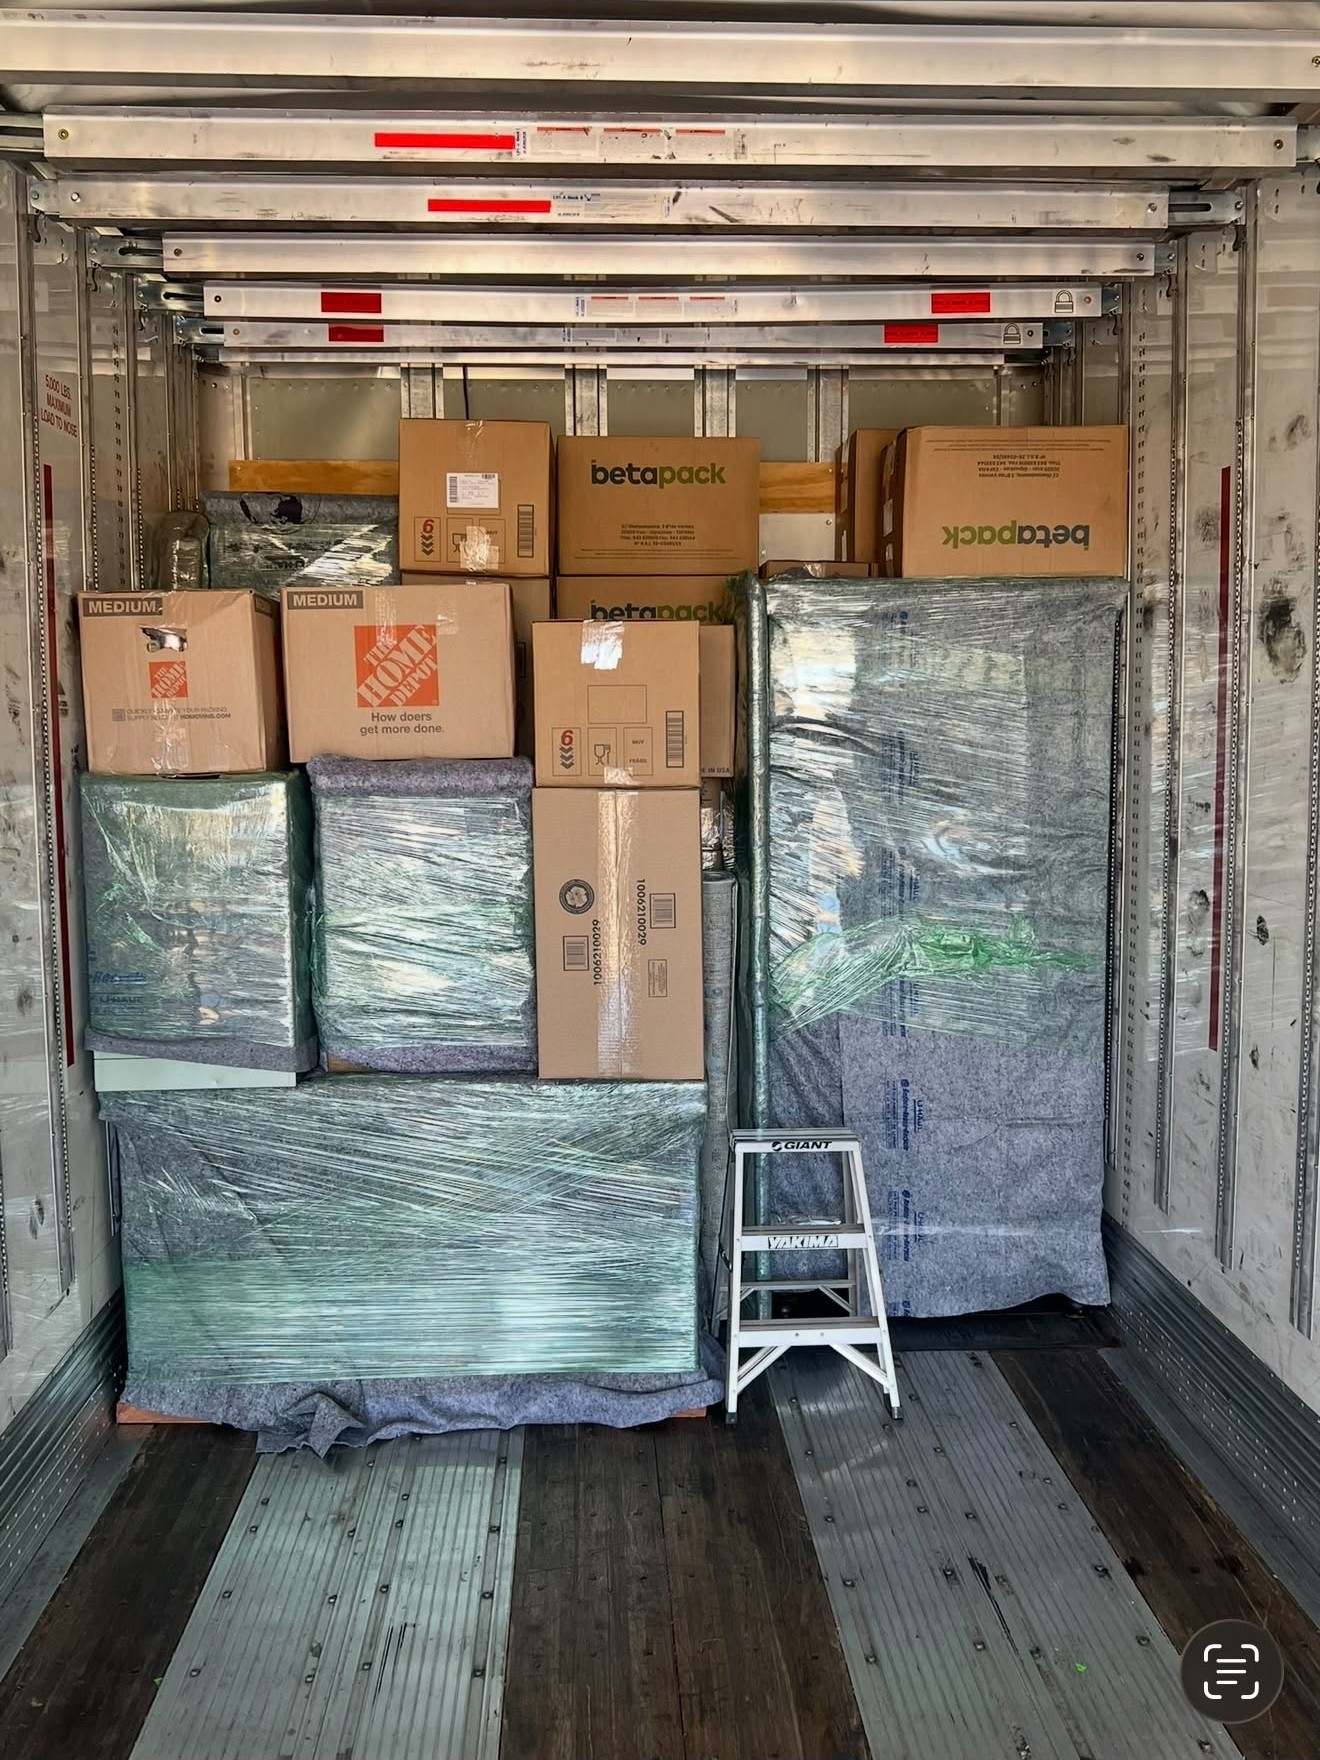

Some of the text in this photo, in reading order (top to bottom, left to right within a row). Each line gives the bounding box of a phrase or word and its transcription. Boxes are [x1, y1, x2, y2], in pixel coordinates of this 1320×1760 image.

[46, 391, 72, 418] MAXIMUM
[40, 407, 55, 426] LOAD
[63, 419, 78, 438] NOSE
[591, 460, 726, 489] betapack
[422, 519, 435, 534] 6
[942, 520, 1090, 550] betapack
[88, 600, 156, 614] MEDIUM
[293, 594, 357, 606] MEDIUM
[590, 600, 725, 621] betapack
[358, 625, 436, 707] HOME
[363, 640, 397, 667] THE
[151, 661, 186, 698] HOME
[389, 654, 438, 707] DEPOT
[360, 723, 445, 736] get more done.
[371, 711, 432, 722] How doers
[560, 729, 574, 746] 6
[636, 879, 647, 946] 1006210029
[592, 919, 602, 985] 1006210029
[784, 1141, 832, 1150] GIANT
[768, 1236, 839, 1249] YAKIMA
